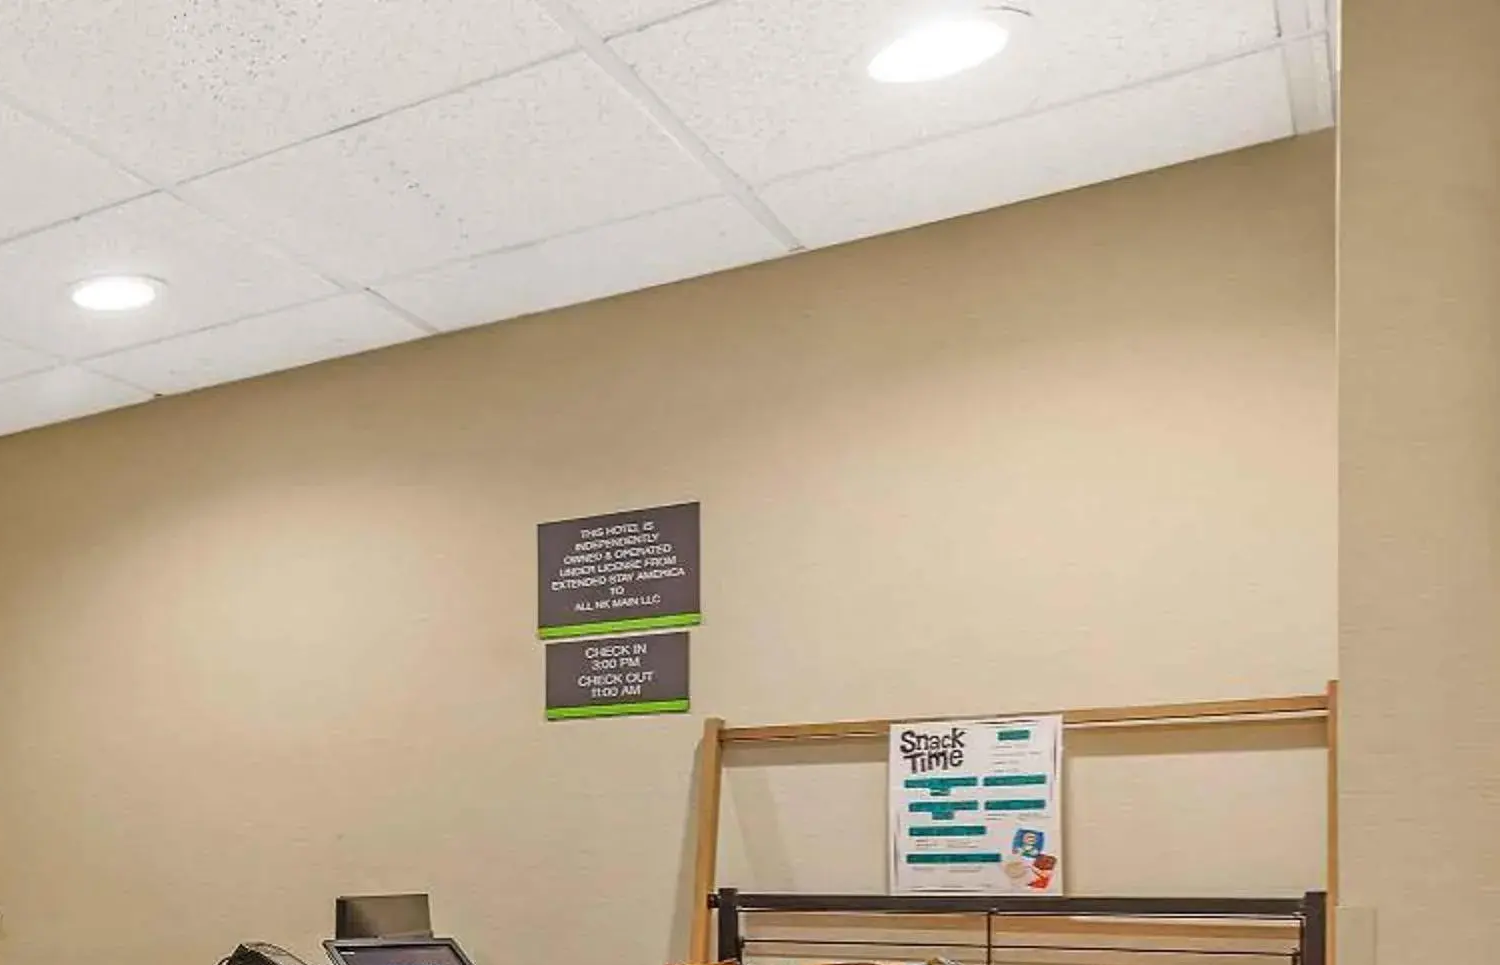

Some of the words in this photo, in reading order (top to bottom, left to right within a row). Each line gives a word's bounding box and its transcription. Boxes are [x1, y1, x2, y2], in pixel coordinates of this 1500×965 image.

[580, 528, 604, 538] THIS
[606, 525, 639, 536] HOTEL
[643, 522, 654, 532] IS
[575, 533, 659, 551] INDEPENDENTLY
[563, 552, 603, 565] OWNED
[614, 544, 671, 559] OPERATED
[559, 565, 596, 577] UNDER
[598, 560, 642, 573] LICENSE
[644, 556, 676, 568] FROM
[551, 577, 607, 591] EXTENDED
[610, 574, 634, 585] STAY
[637, 567, 685, 581] AMERICA
[610, 587, 624, 596] TO
[574, 601, 593, 611] ALL
[612, 597, 639, 608] MAIN
[641, 594, 661, 604] LLC
[585, 645, 631, 659] CHECK
[633, 643, 647, 655] IN
[592, 658, 617, 670] 3:00
[620, 656, 640, 668] PM
[577, 673, 623, 687] CHECK
[626, 671, 655, 684] OUT
[592, 685, 618, 698] 11:00
[621, 684, 641, 696] AM
[900, 728, 968, 754] Snack
